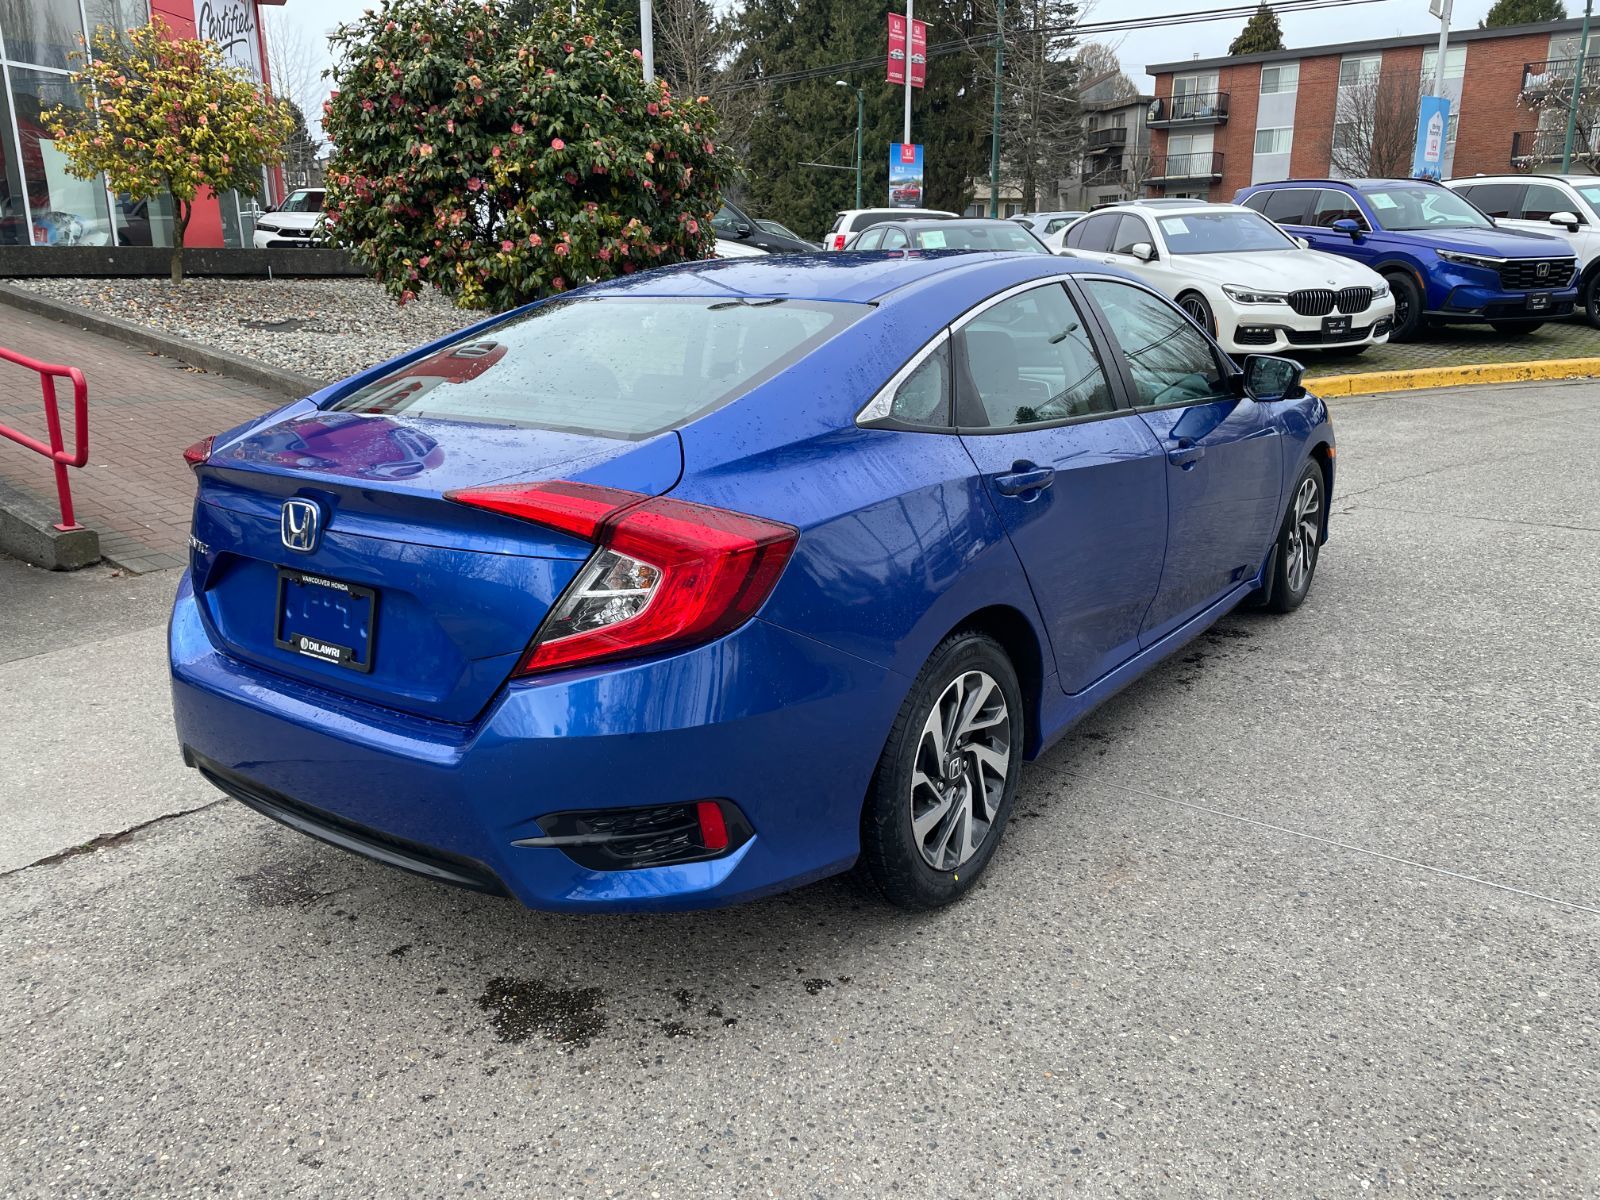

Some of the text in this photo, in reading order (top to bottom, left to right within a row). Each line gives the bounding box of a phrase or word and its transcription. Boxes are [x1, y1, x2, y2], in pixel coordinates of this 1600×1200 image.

[302, 575, 349, 591] VANCOUVER HONDA
[309, 641, 340, 658] DILAWRI
